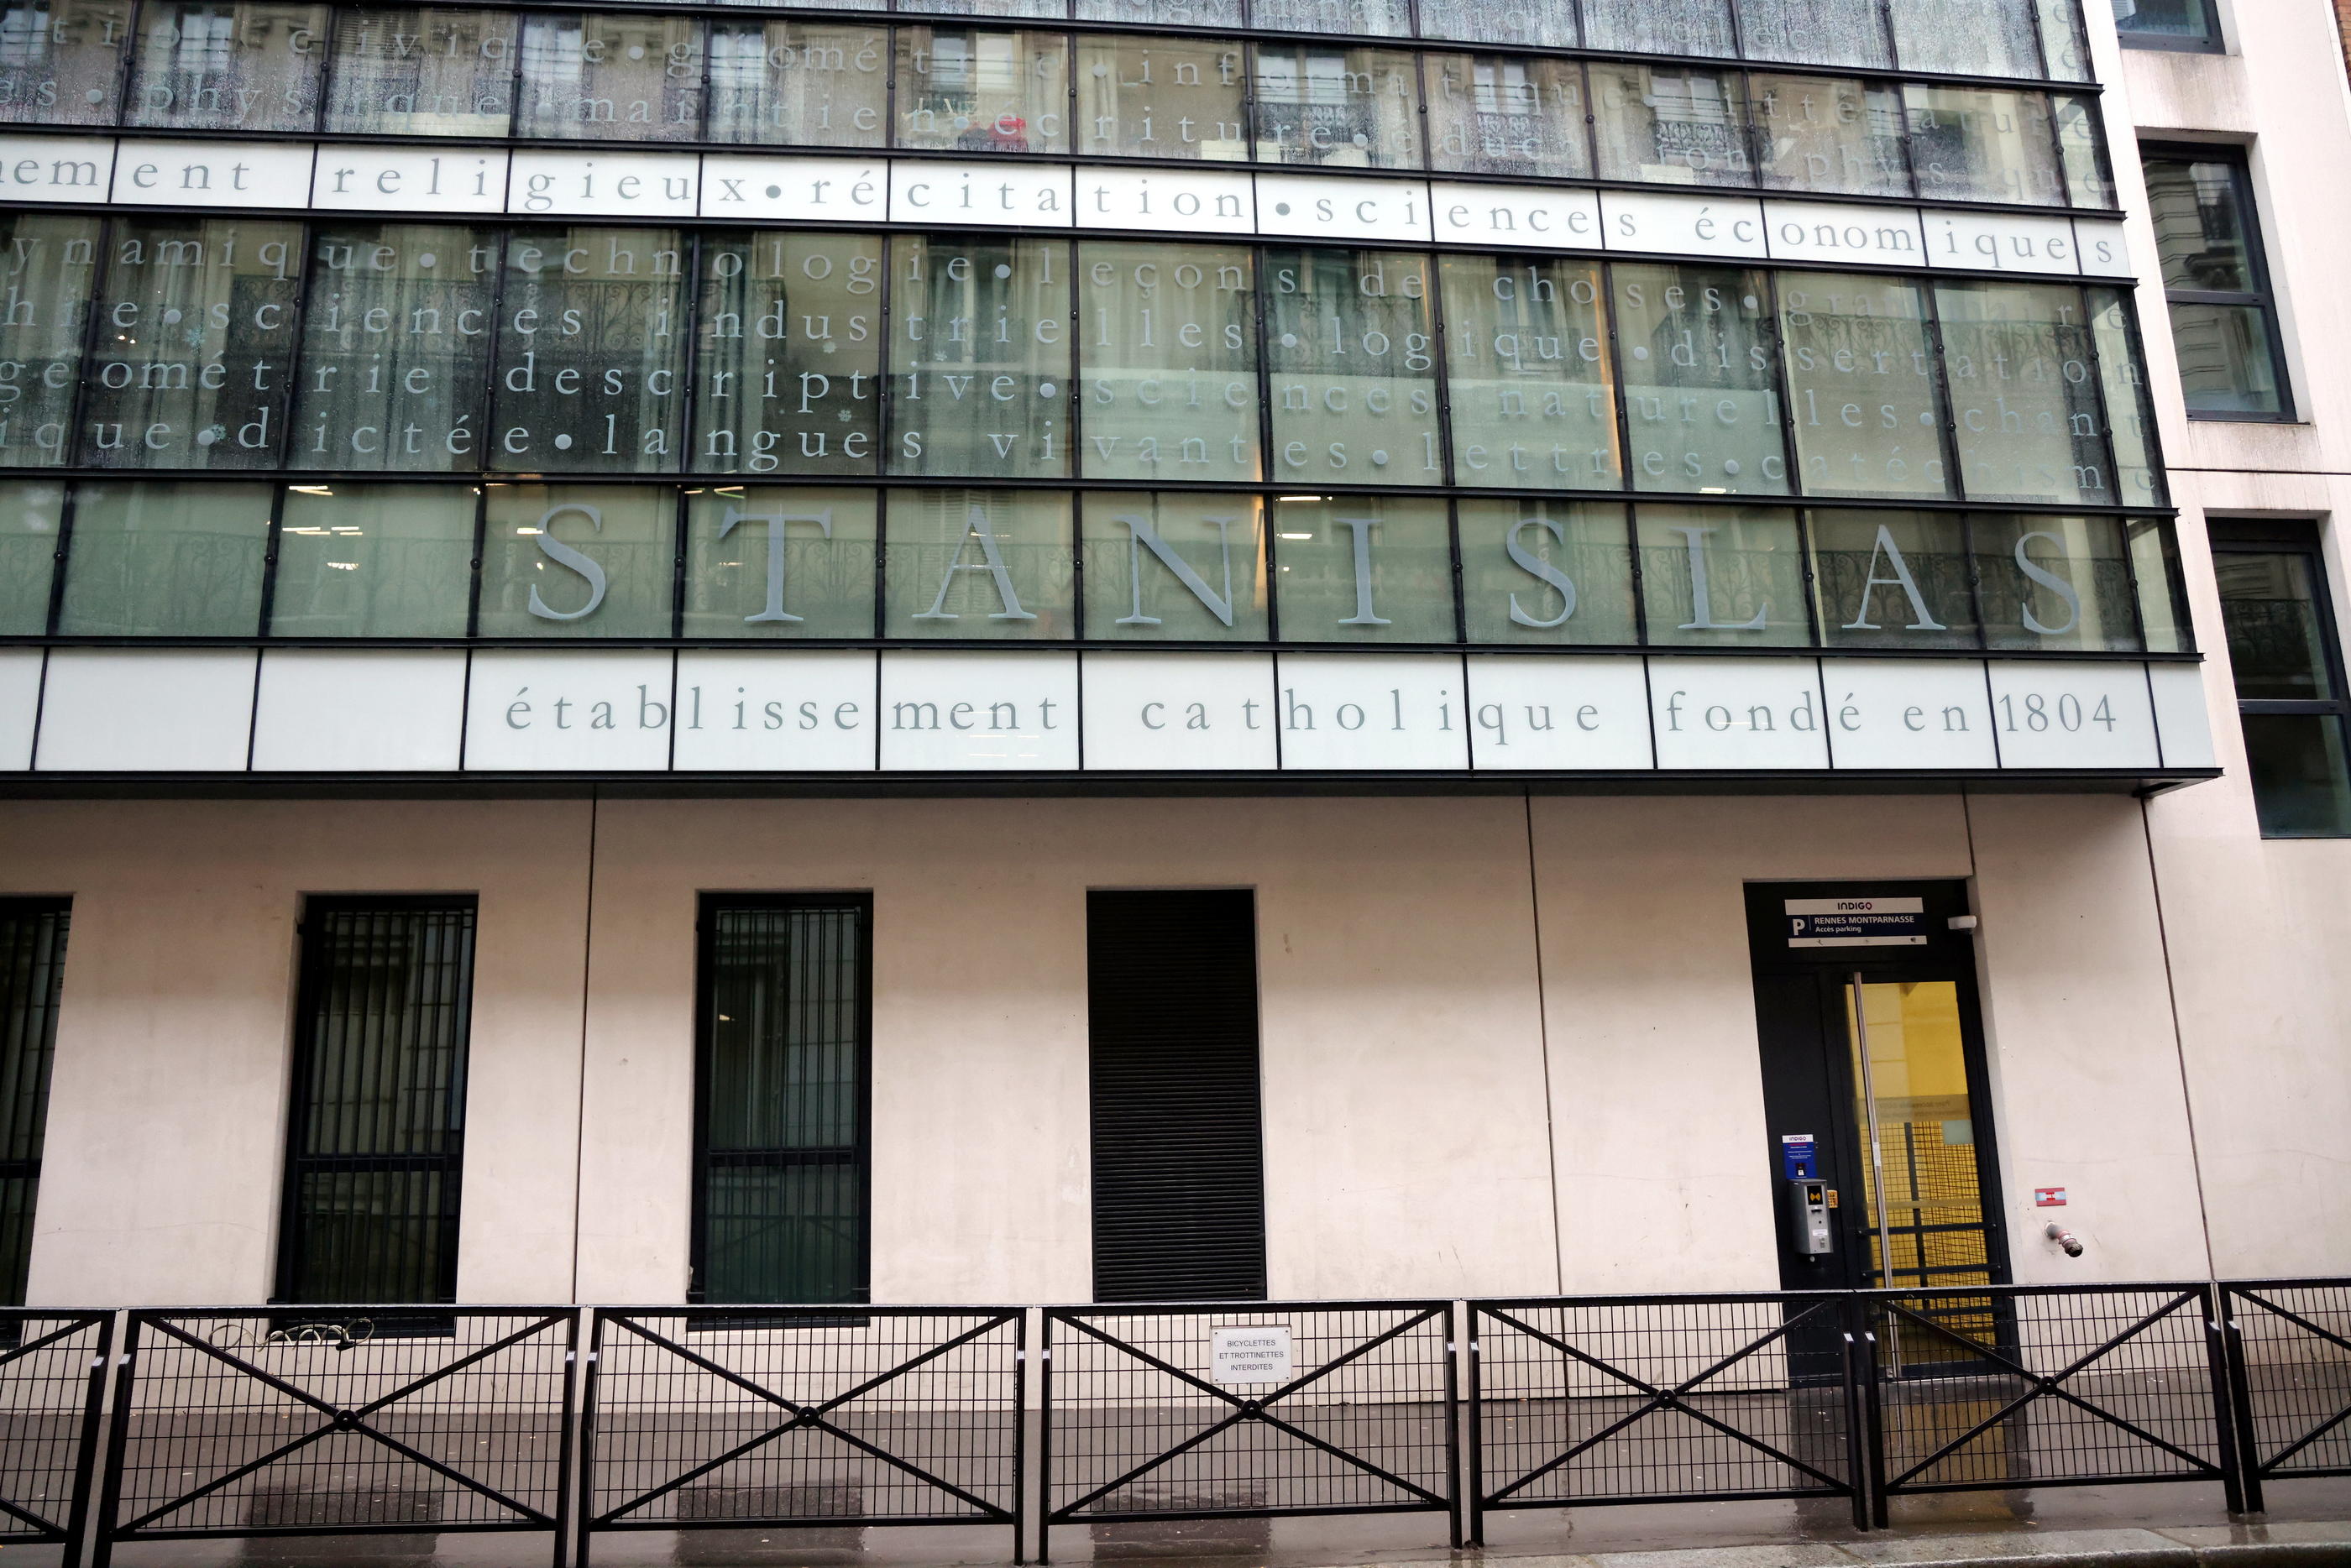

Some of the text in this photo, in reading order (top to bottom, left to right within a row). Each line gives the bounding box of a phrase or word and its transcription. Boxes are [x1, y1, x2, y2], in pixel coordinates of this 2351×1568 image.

[573, 89, 938, 133] maintien
[994, 102, 1333, 149] écriture
[1806, 144, 2101, 201] physque
[332, 158, 746, 212] religieux
[810, 170, 1244, 217] récitation
[1317, 191, 1636, 238] sciences
[1694, 207, 2112, 268] économiques
[469, 235, 970, 295] technologie
[1039, 248, 1296, 299] leçons
[1360, 261, 1424, 299] de
[1493, 266, 1720, 311] choses
[211, 293, 581, 335] sciences
[657, 297, 1243, 350] industrielles
[1332, 317, 1600, 371] logique
[1671, 331, 2143, 386] dissertation
[505, 353, 1015, 414] descriptive
[1095, 368, 1429, 415] sciences
[1500, 386, 1898, 430] naturelles
[1965, 398, 2144, 438] chant
[238, 407, 529, 456] dictée
[602, 415, 922, 472] langues
[987, 421, 1347, 468] vivantes
[1423, 432, 1701, 478] lettres
[1762, 446, 2155, 492] catéchisme
[528, 504, 2080, 635] STANISLAS
[505, 683, 2116, 745] établissement catholique fondé en 1804
[1793, 918, 1805, 936] P
[1814, 916, 1914, 925] RENNES MONTPARNASSE
[1835, 925, 1861, 933] parking
[1230, 1351, 1284, 1359] TROTTINETTES
